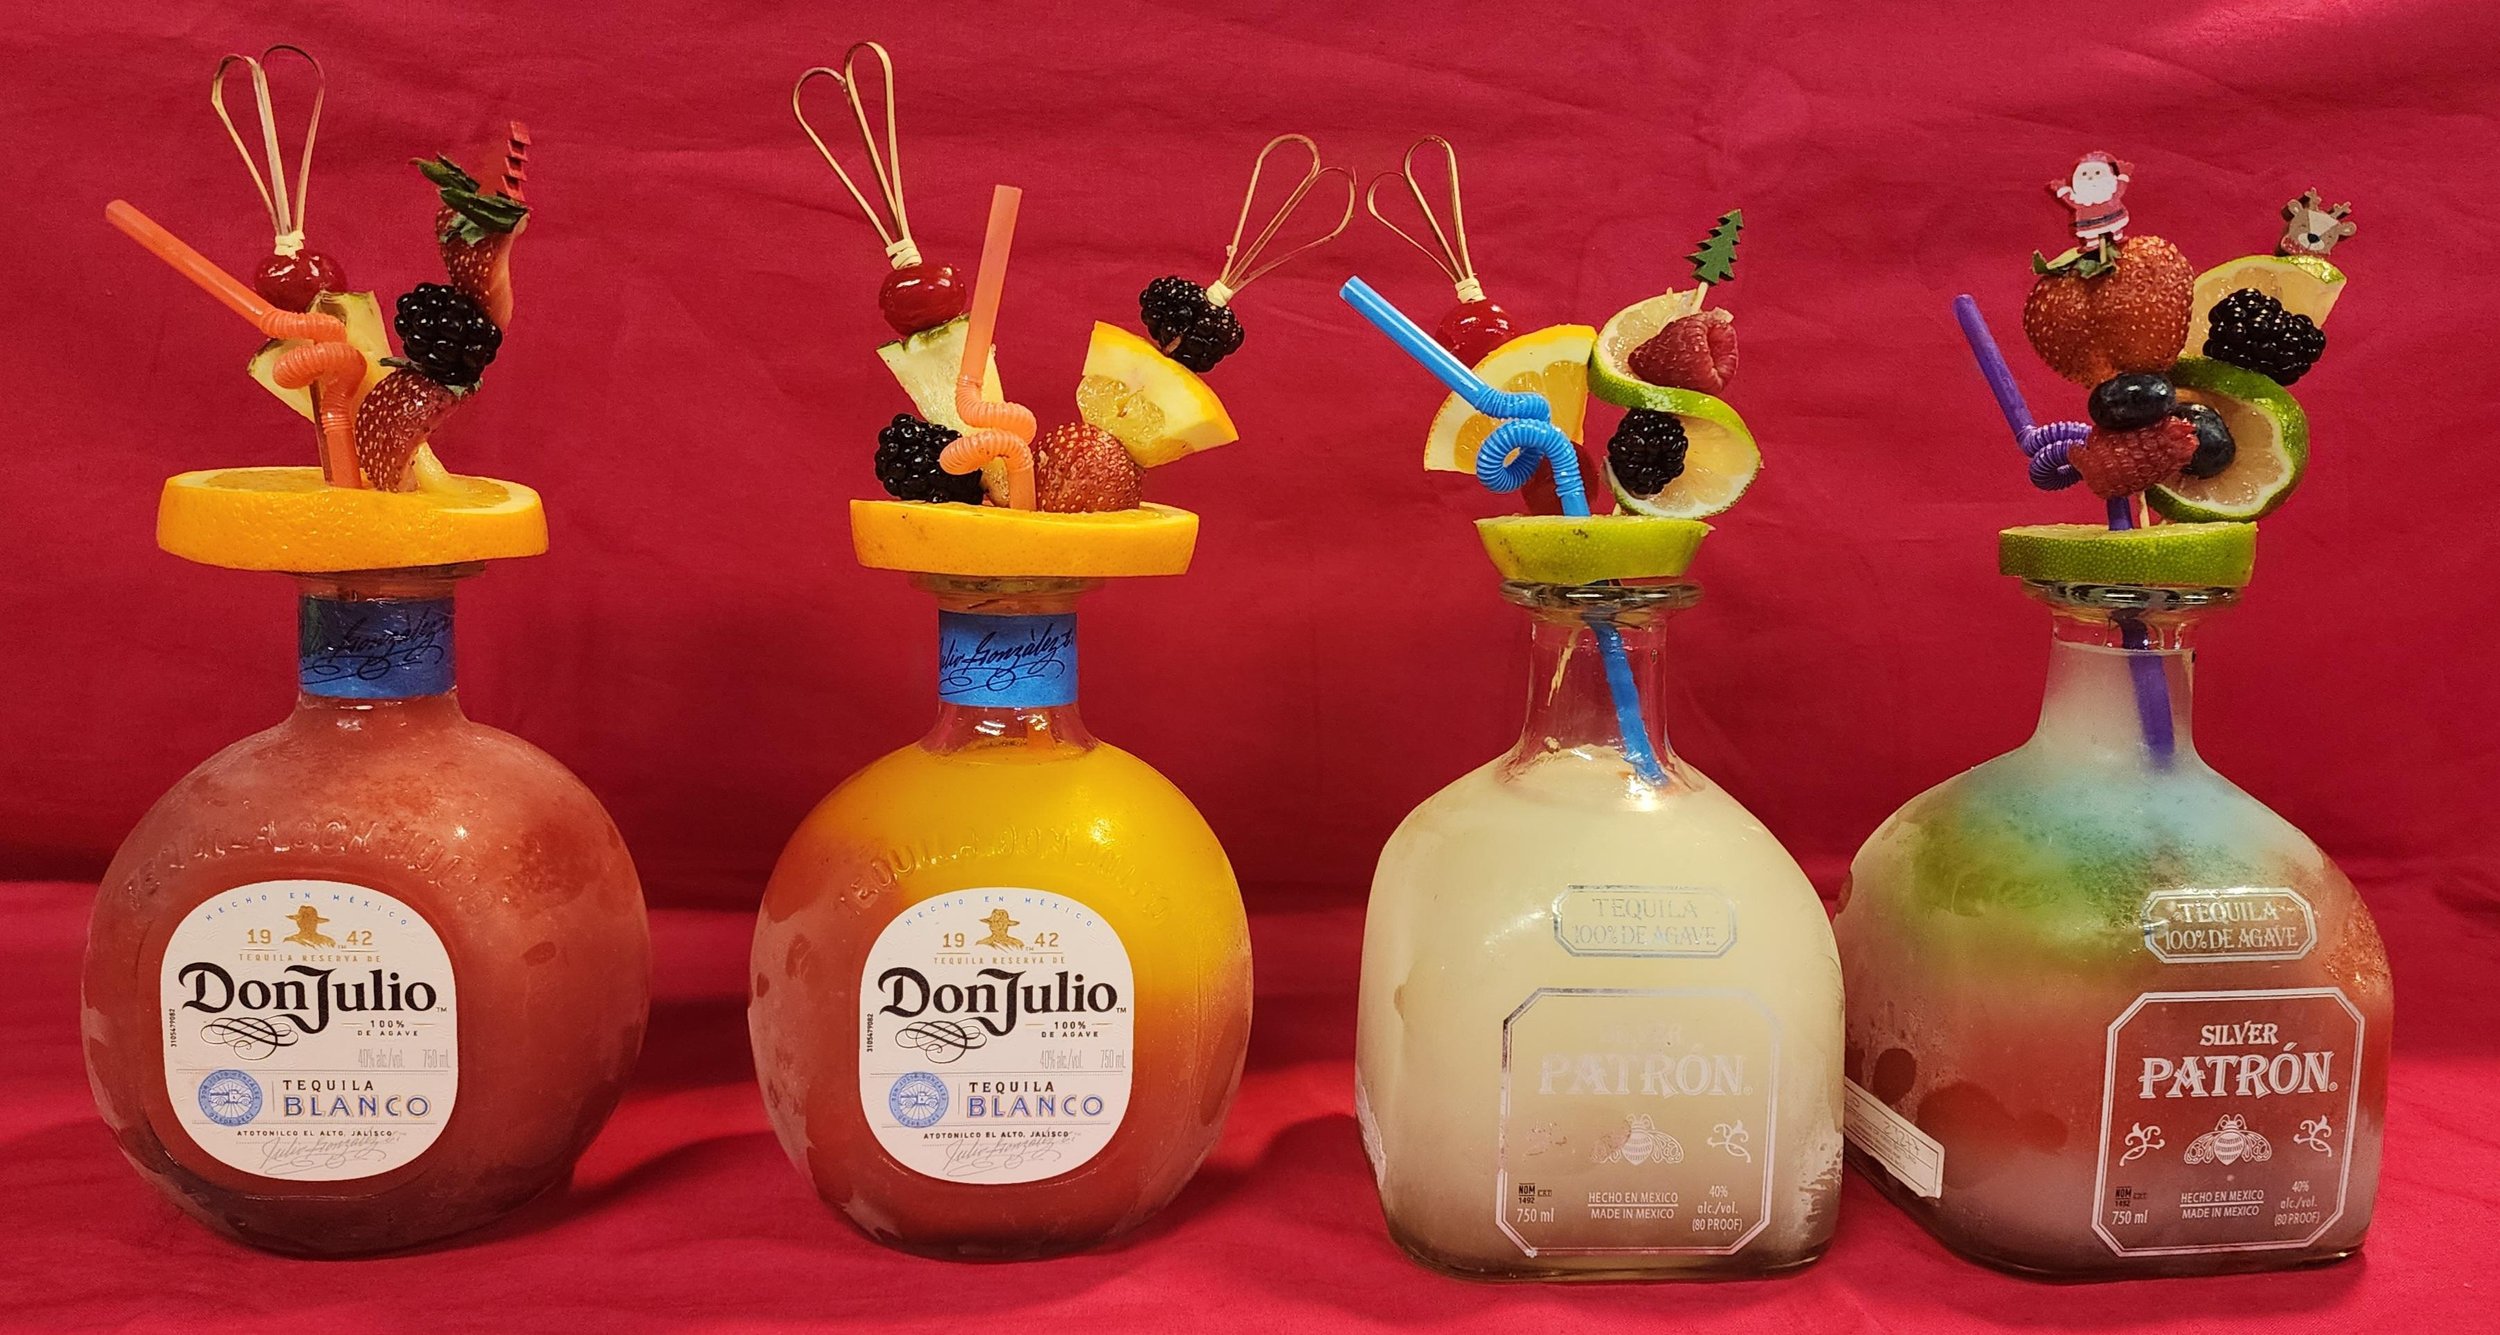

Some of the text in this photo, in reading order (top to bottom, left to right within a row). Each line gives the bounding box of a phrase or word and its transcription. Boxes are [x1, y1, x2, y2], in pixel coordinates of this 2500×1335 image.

[205, 892, 408, 926] HECHO EN MÉXICO
[904, 898, 964, 927] HECHO
[1025, 897, 1092, 928] MÉXICO
[1591, 898, 1698, 919] TEQUILA
[2177, 901, 2280, 923] TEQUILA
[247, 929, 374, 946] 19 42
[942, 932, 1059, 948] 19 42
[1572, 925, 1717, 945] 100% DE AGAVE
[2165, 927, 2298, 950] 100% DE AGAVE
[238, 953, 293, 962] TEQUILA
[934, 957, 984, 965] TEQUILA
[370, 1020, 405, 1028] 100%
[1054, 1021, 1086, 1030] 100%
[2200, 1020, 2279, 1046] SILVER
[283, 1080, 374, 1091] TEQUILA
[969, 1081, 1054, 1093] TEQUILA
[284, 1094, 431, 1118] BLANCO
[968, 1095, 1104, 1118] BLANCO
[924, 1131, 981, 1139] ATOTONILCO
[1518, 1185, 1535, 1195] NOM
[1709, 1185, 1728, 1198] 40%
[2292, 1180, 2309, 1192] 40%
[1589, 1192, 1678, 1203] HECHO EN MEXICO
[2181, 1190, 2264, 1203] HECHO EN MEXICO
[1517, 1207, 1554, 1223] 750 ml
[1591, 1208, 1674, 1219] MADE IN MEXICO
[1697, 1203, 1738, 1214] alc./vol.
[2182, 1206, 2259, 1219] MADE IN MEXICO
[2112, 1209, 2148, 1225] 750 ml
[2274, 1212, 2320, 1227] (80 PROOF)
[1692, 1218, 1743, 1232] (80 PROOF)
